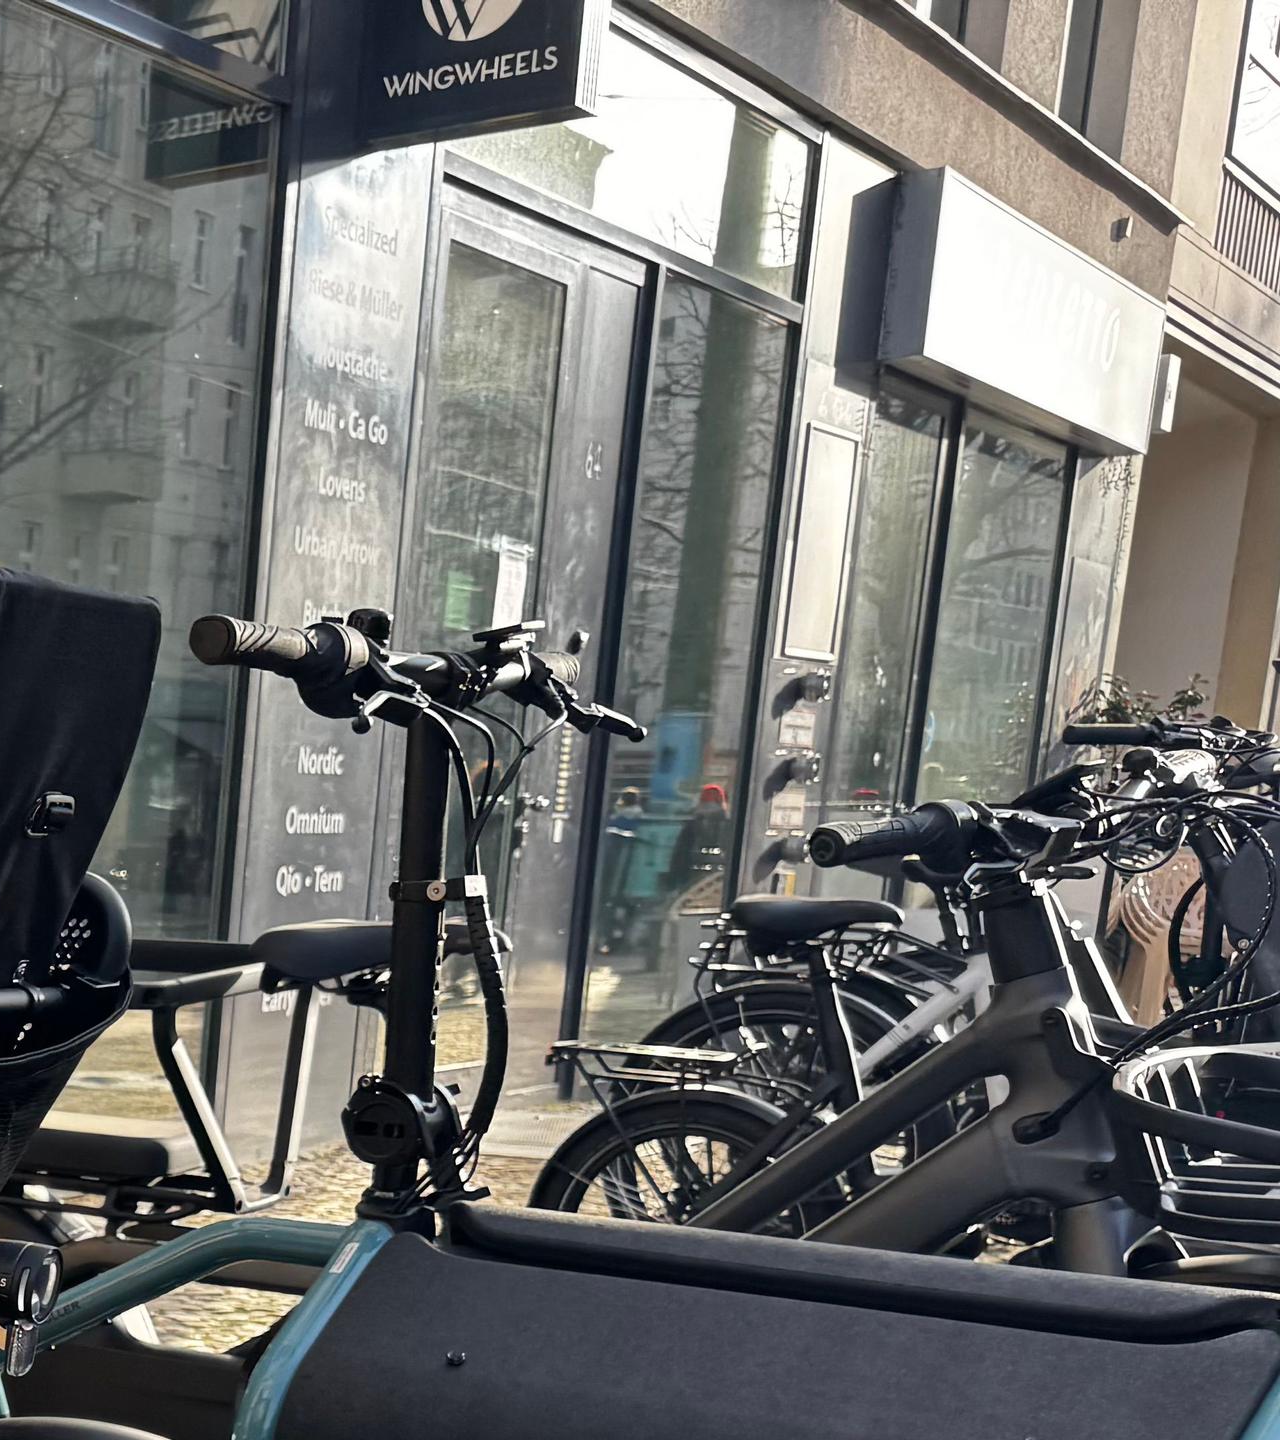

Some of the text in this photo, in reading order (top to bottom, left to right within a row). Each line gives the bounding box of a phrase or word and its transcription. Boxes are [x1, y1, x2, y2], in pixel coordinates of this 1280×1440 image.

[383, 46, 559, 98] WINGWHEELS
[324, 204, 400, 257] Specialized
[307, 267, 344, 303] Riese
[304, 399, 389, 445] Muli Ca Go
[318, 466, 366, 502] Lovens
[294, 525, 382, 566] Urban Arrow
[297, 744, 344, 776] Nordic
[285, 804, 345, 834] Omnium
[275, 865, 344, 897] Qio Tern
